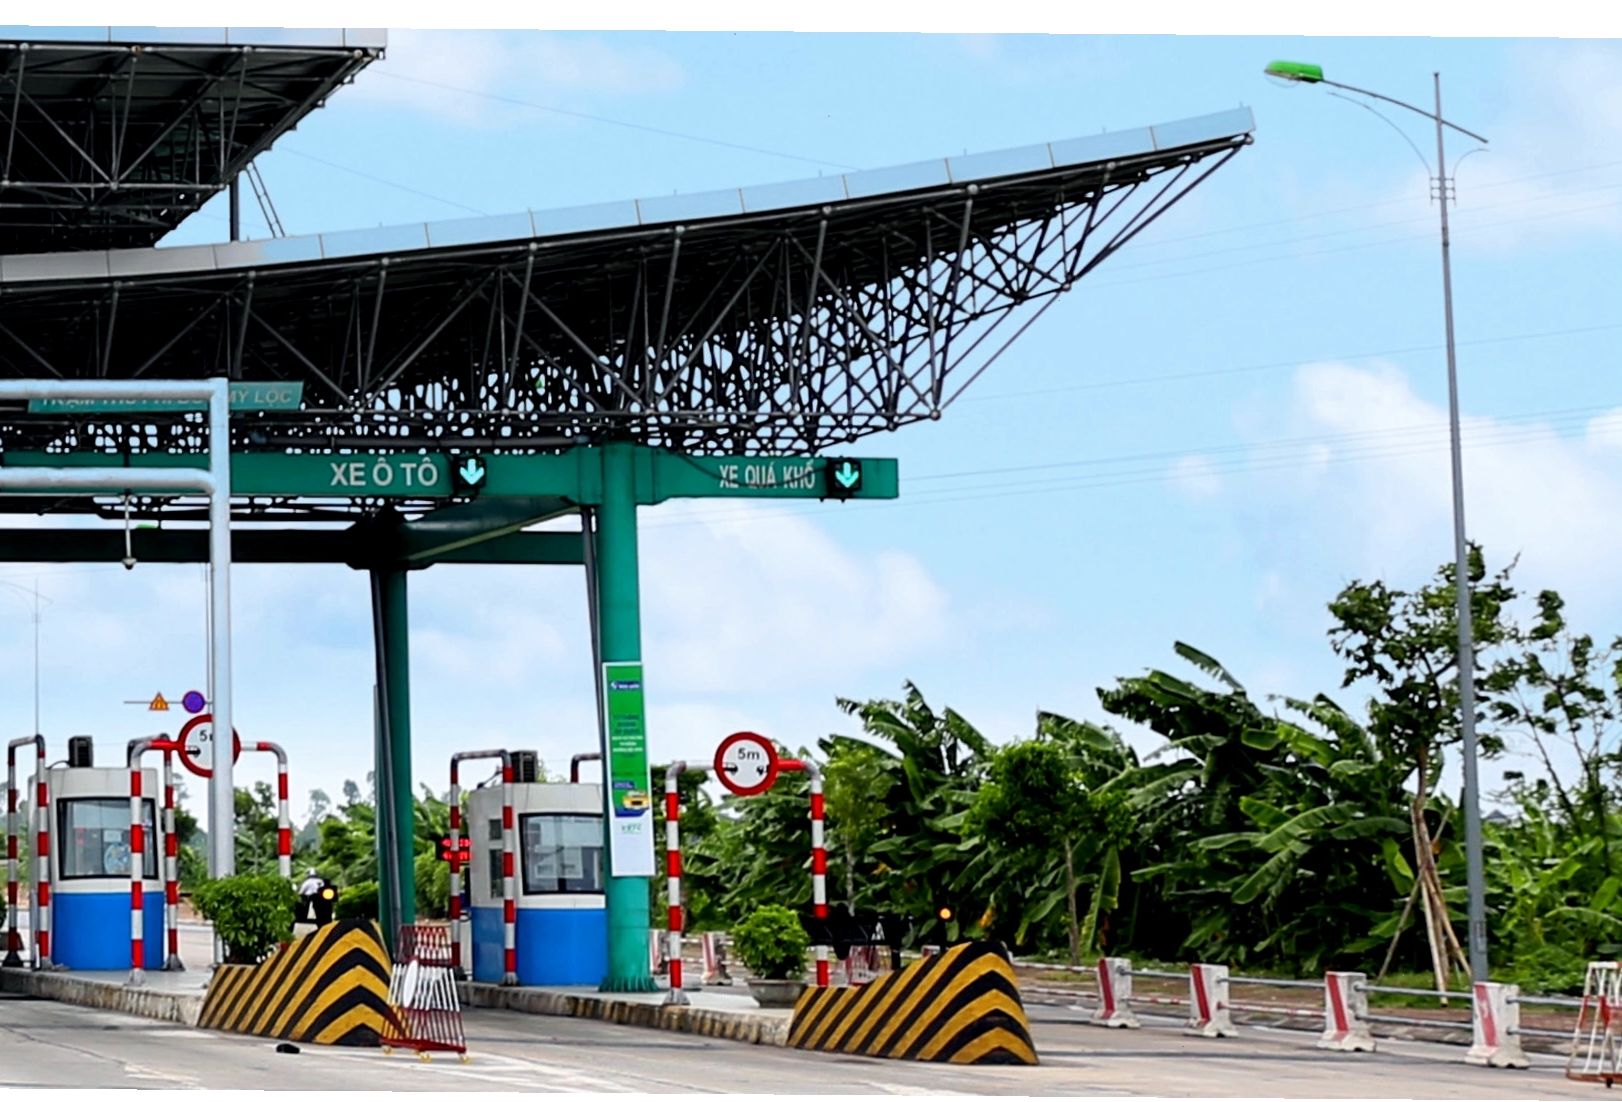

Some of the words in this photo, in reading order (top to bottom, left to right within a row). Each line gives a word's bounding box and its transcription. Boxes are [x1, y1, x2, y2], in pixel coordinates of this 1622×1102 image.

[330, 463, 366, 486] XE
[372, 457, 393, 486] Ô
[400, 457, 438, 486] TÔ
[719, 465, 739, 488] XE
[745, 461, 776, 489] QUÁ
[199, 729, 213, 742] 5
[738, 747, 760, 760] 5m
